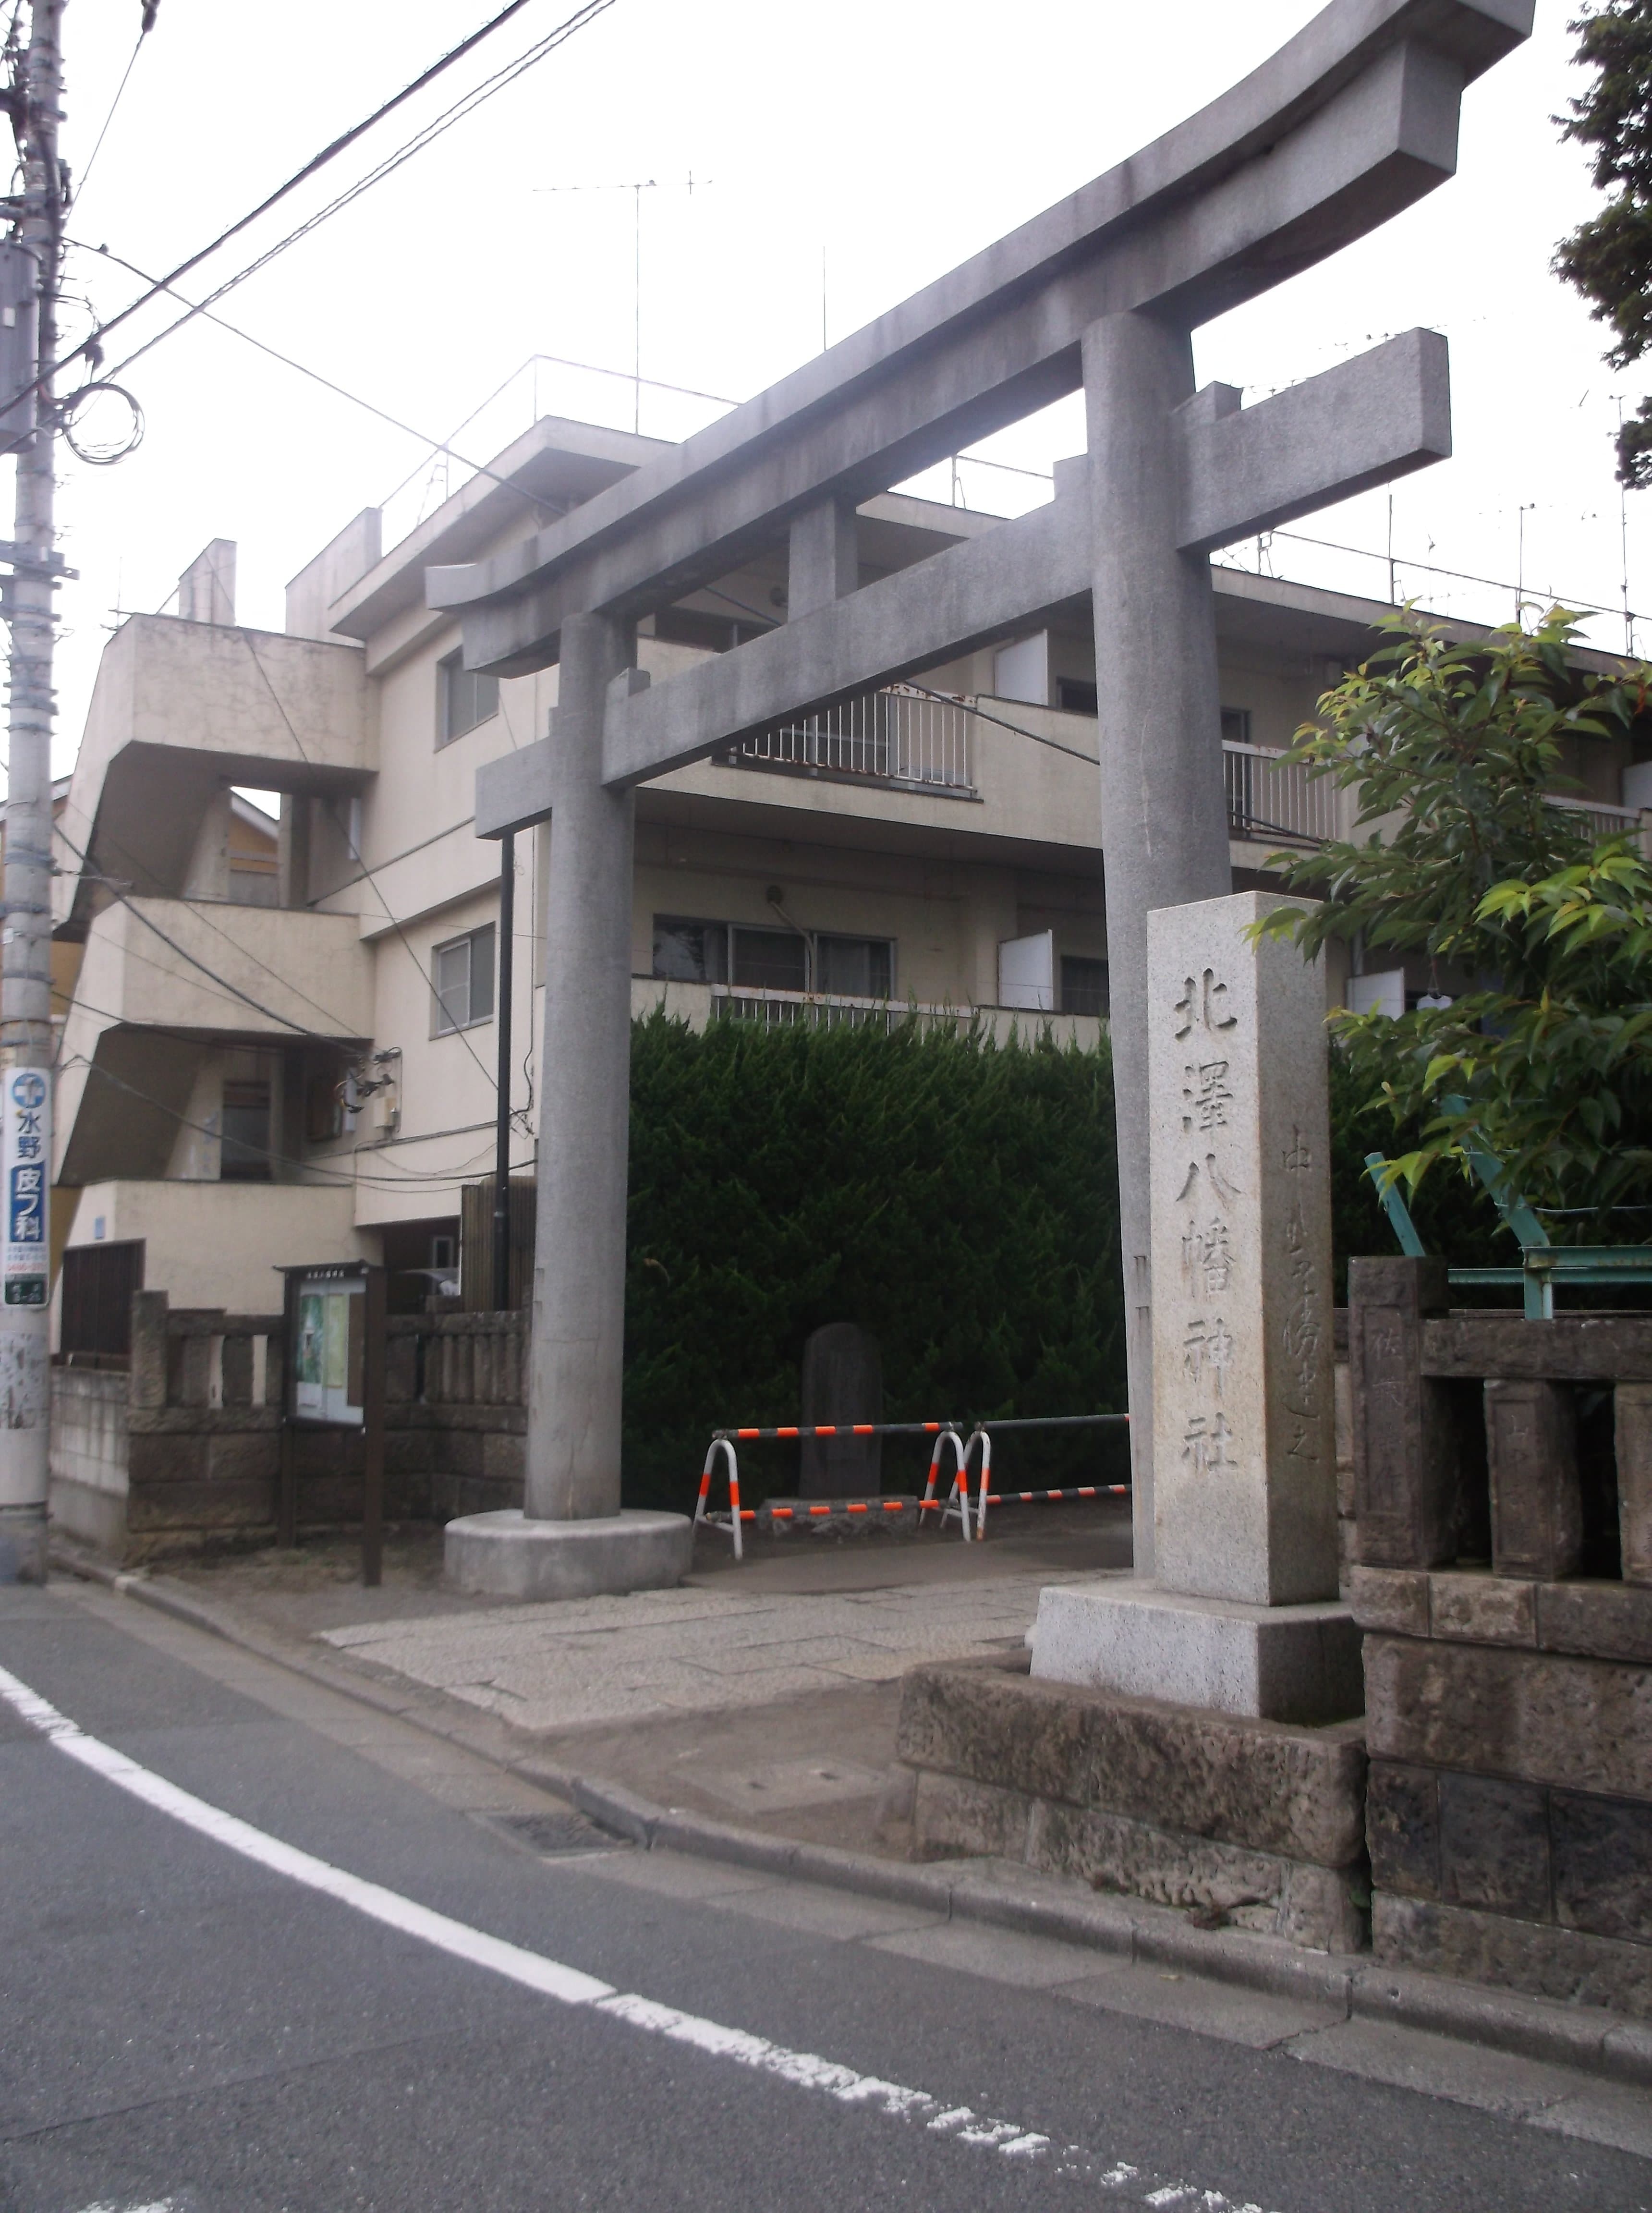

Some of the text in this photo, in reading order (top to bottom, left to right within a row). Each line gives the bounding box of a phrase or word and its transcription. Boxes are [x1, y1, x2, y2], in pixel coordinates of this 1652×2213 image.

[1173, 967, 1247, 1471] 北澤八幡神社
